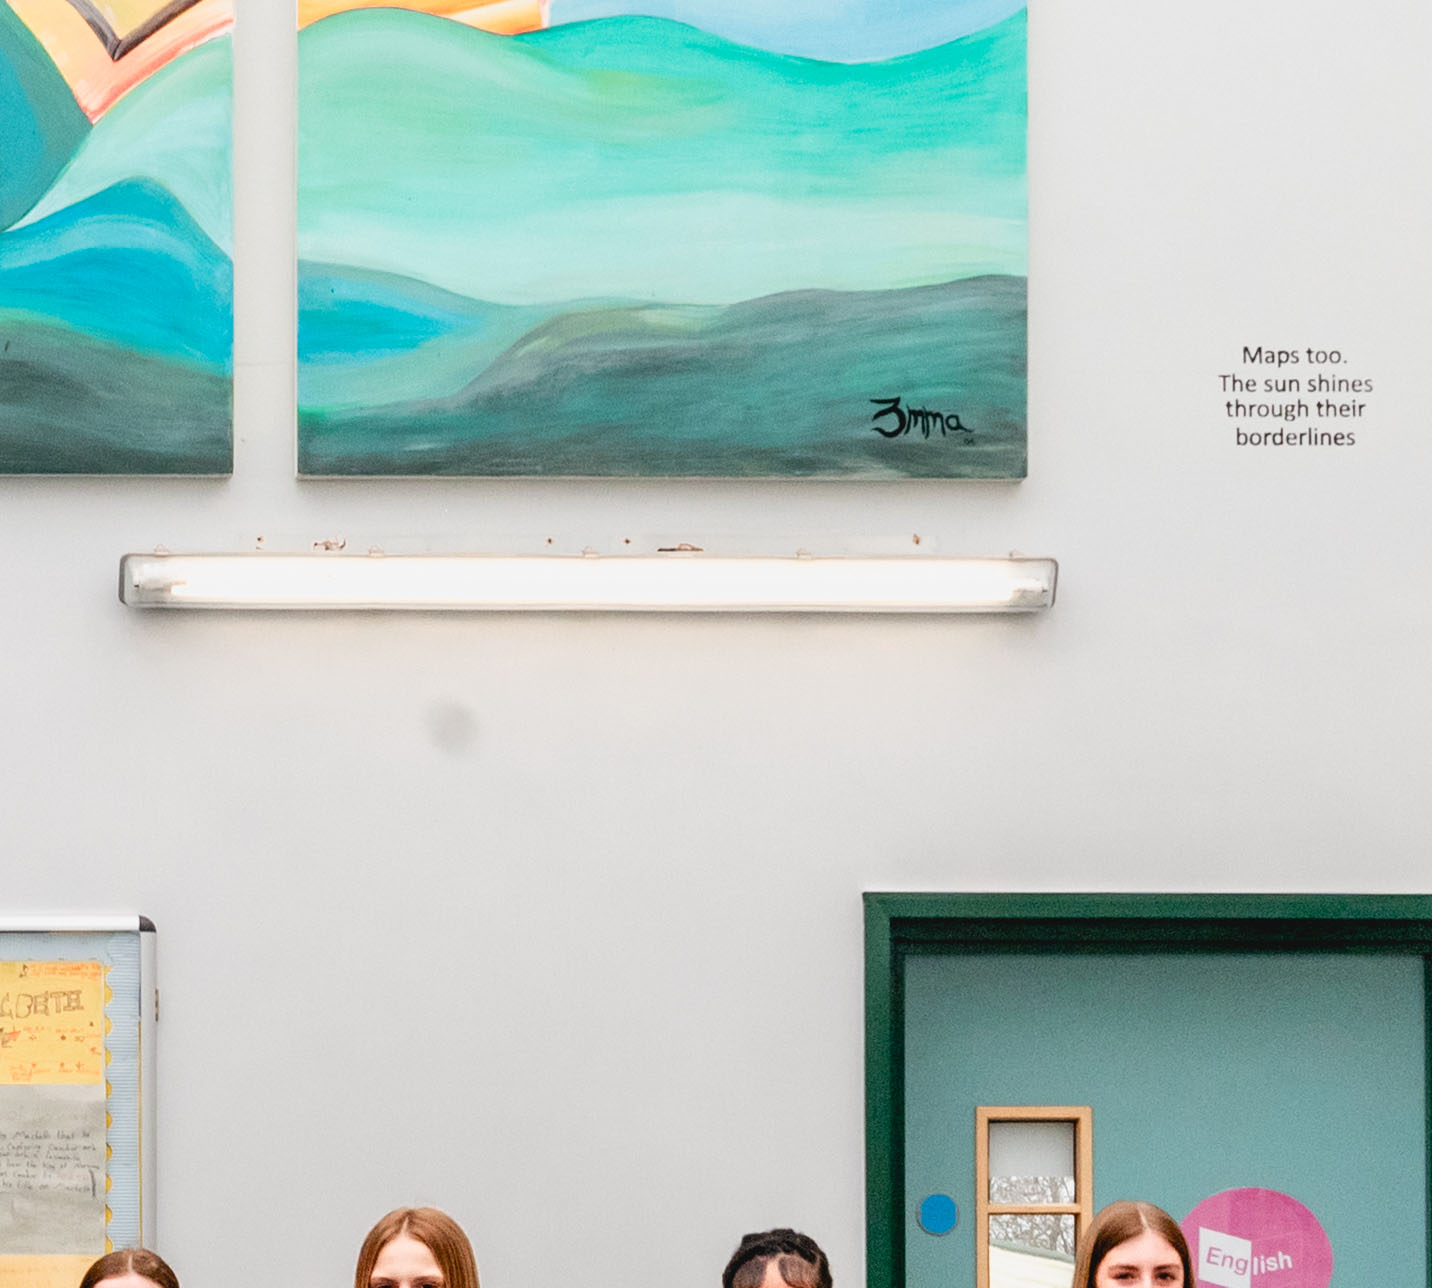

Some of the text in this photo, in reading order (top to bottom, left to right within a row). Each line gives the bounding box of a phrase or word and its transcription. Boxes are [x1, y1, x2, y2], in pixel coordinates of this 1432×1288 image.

[1242, 346, 1350, 368] Maps too.
[1218, 373, 1373, 393] The sun shines
[1225, 398, 1366, 422] through their
[1236, 427, 1356, 447] borderlines
[1205, 1246, 1294, 1276] English
